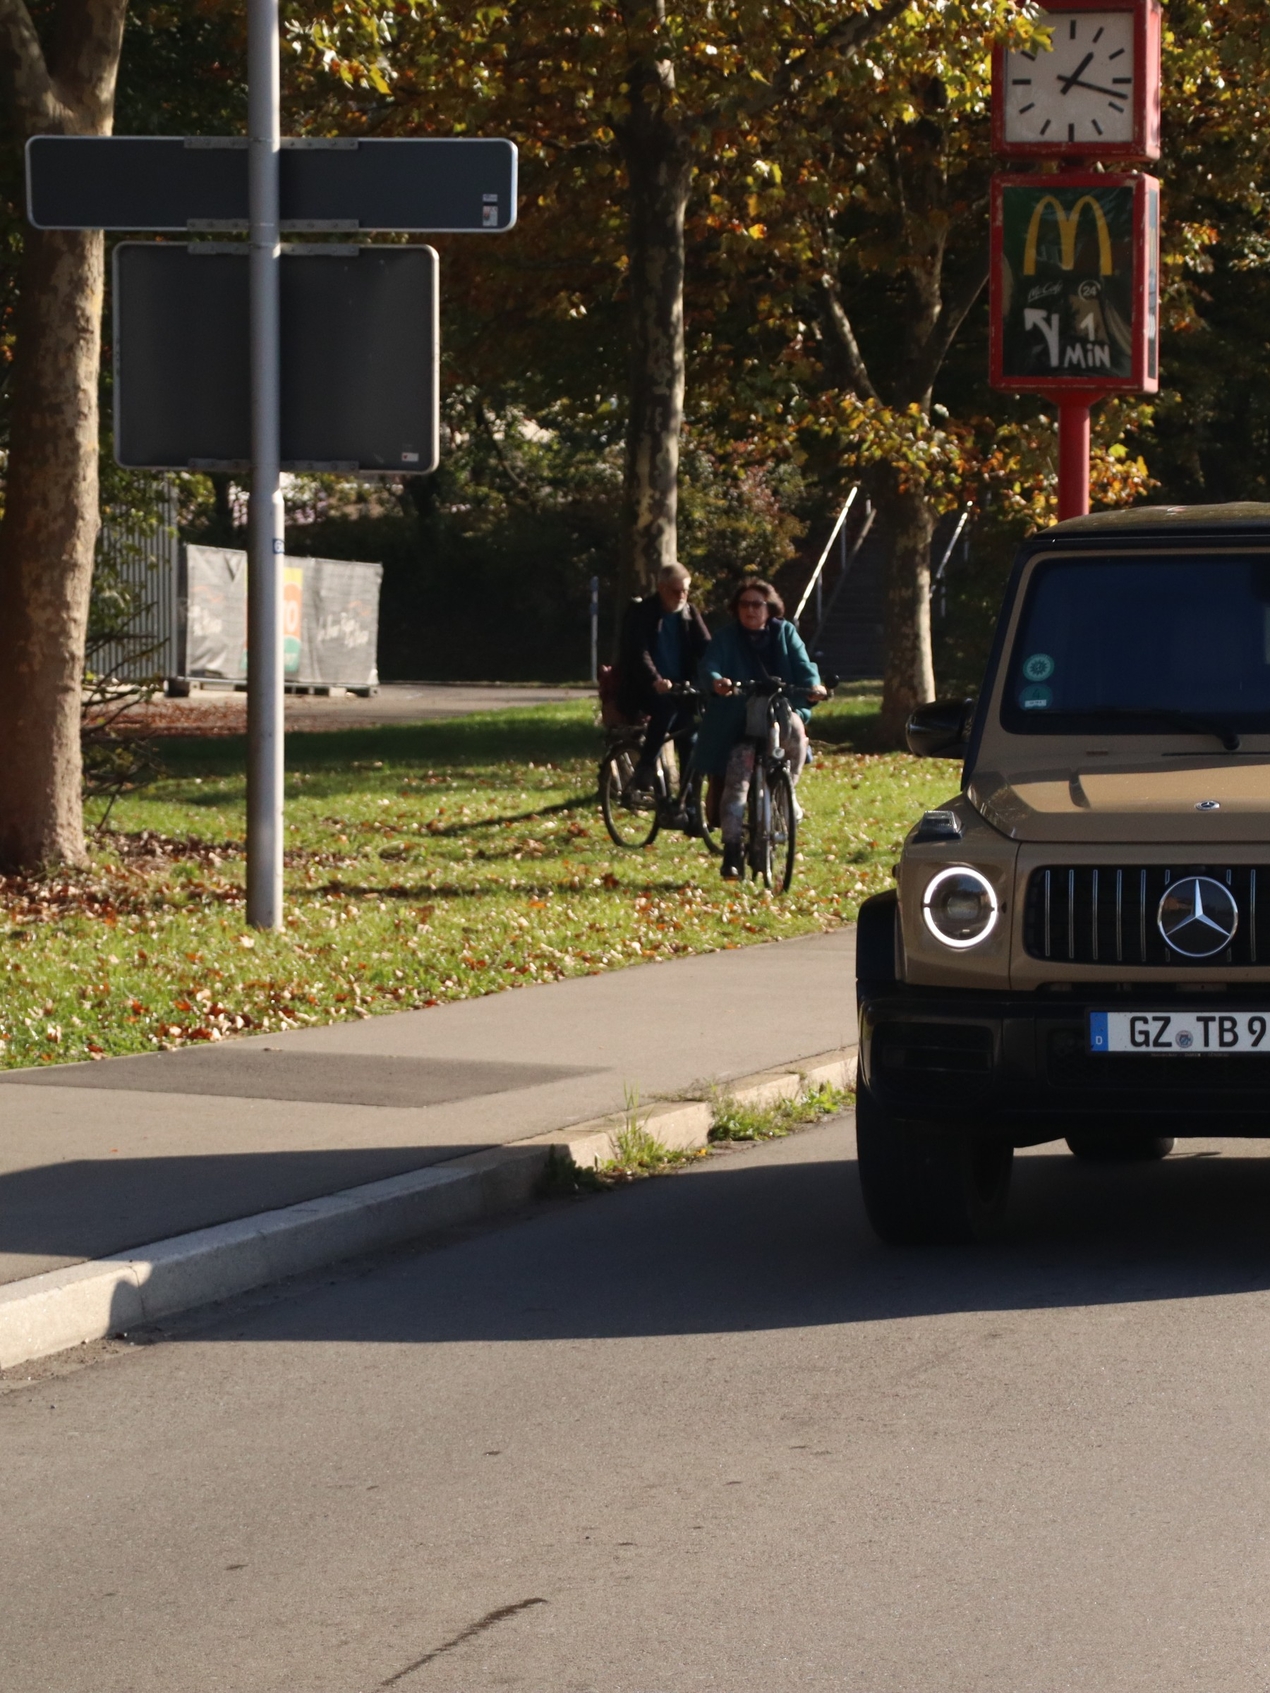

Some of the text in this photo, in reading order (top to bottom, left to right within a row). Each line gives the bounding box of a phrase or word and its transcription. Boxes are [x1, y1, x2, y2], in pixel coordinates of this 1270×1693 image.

[1080, 312, 1095, 342] 1
[1095, 1036, 1103, 1045] D
[1129, 1016, 1267, 1048] GZ TB 9
